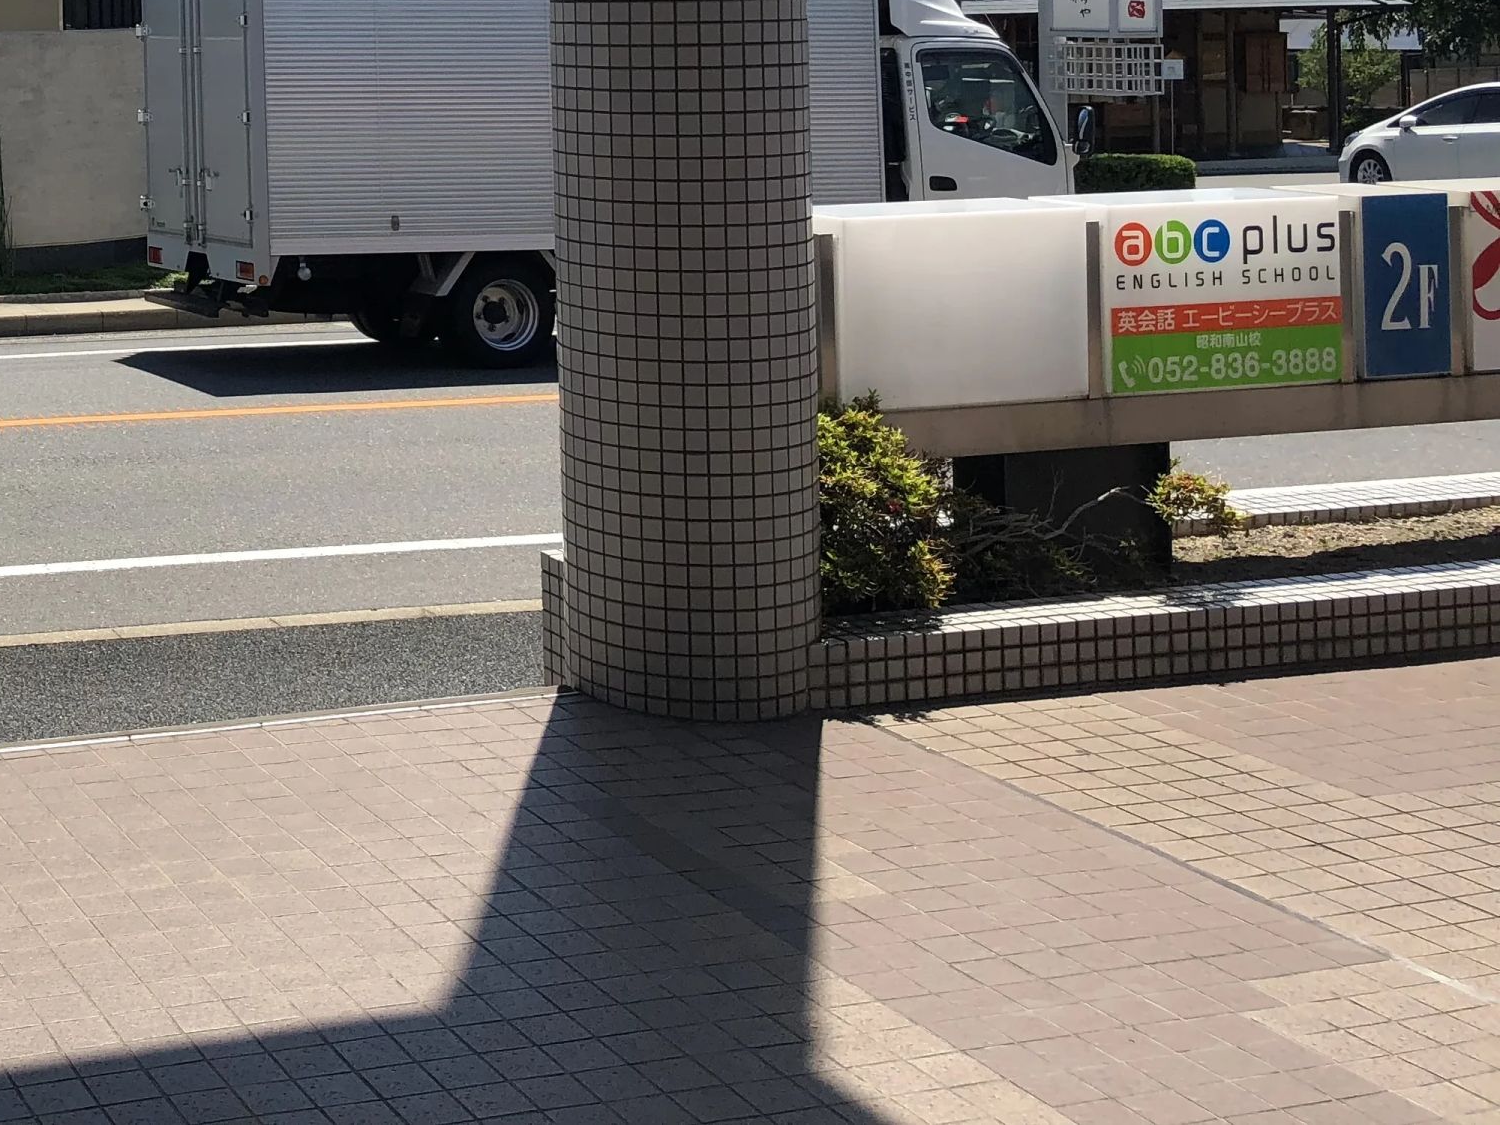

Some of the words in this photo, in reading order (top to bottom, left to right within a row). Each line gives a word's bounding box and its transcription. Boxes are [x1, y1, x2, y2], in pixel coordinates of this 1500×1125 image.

[1119, 220, 1223, 263] abc
[1242, 215, 1336, 265] plus
[1116, 270, 1223, 290] ENGLISH
[1241, 265, 1336, 285] SCHOOL
[1147, 347, 1337, 383] 052-836-3888
